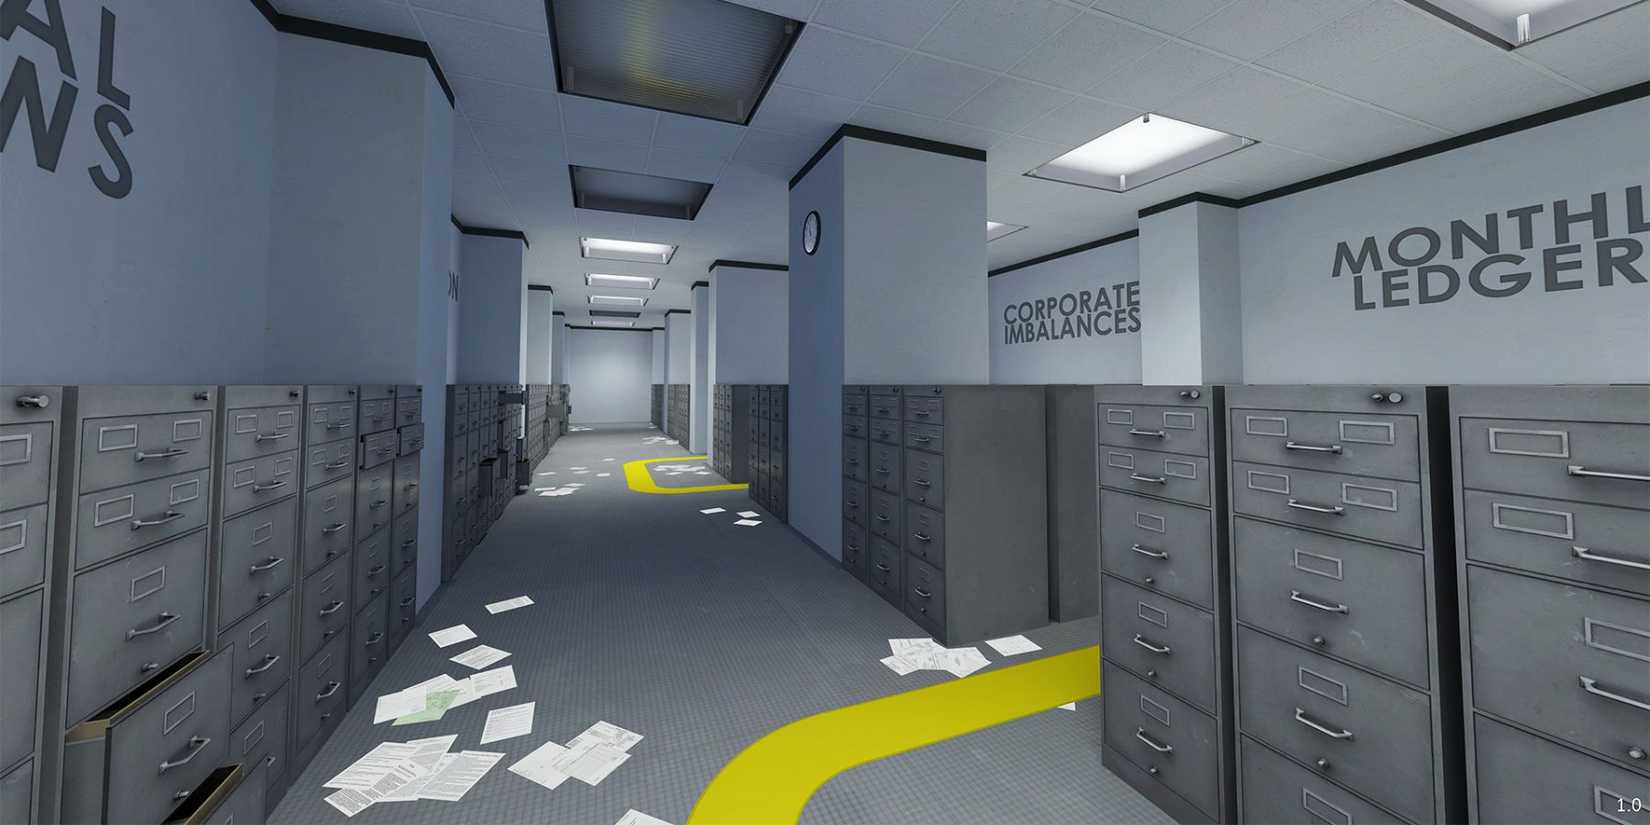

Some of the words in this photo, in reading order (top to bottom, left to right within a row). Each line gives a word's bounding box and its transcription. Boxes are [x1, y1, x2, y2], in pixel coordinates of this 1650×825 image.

[0, 55, 134, 199] NS
[1332, 185, 1650, 278] MONTHL
[1004, 280, 1140, 325] CORPORATE
[1353, 237, 1649, 311] LEDGER
[1004, 307, 1141, 345] IMBALANCES
